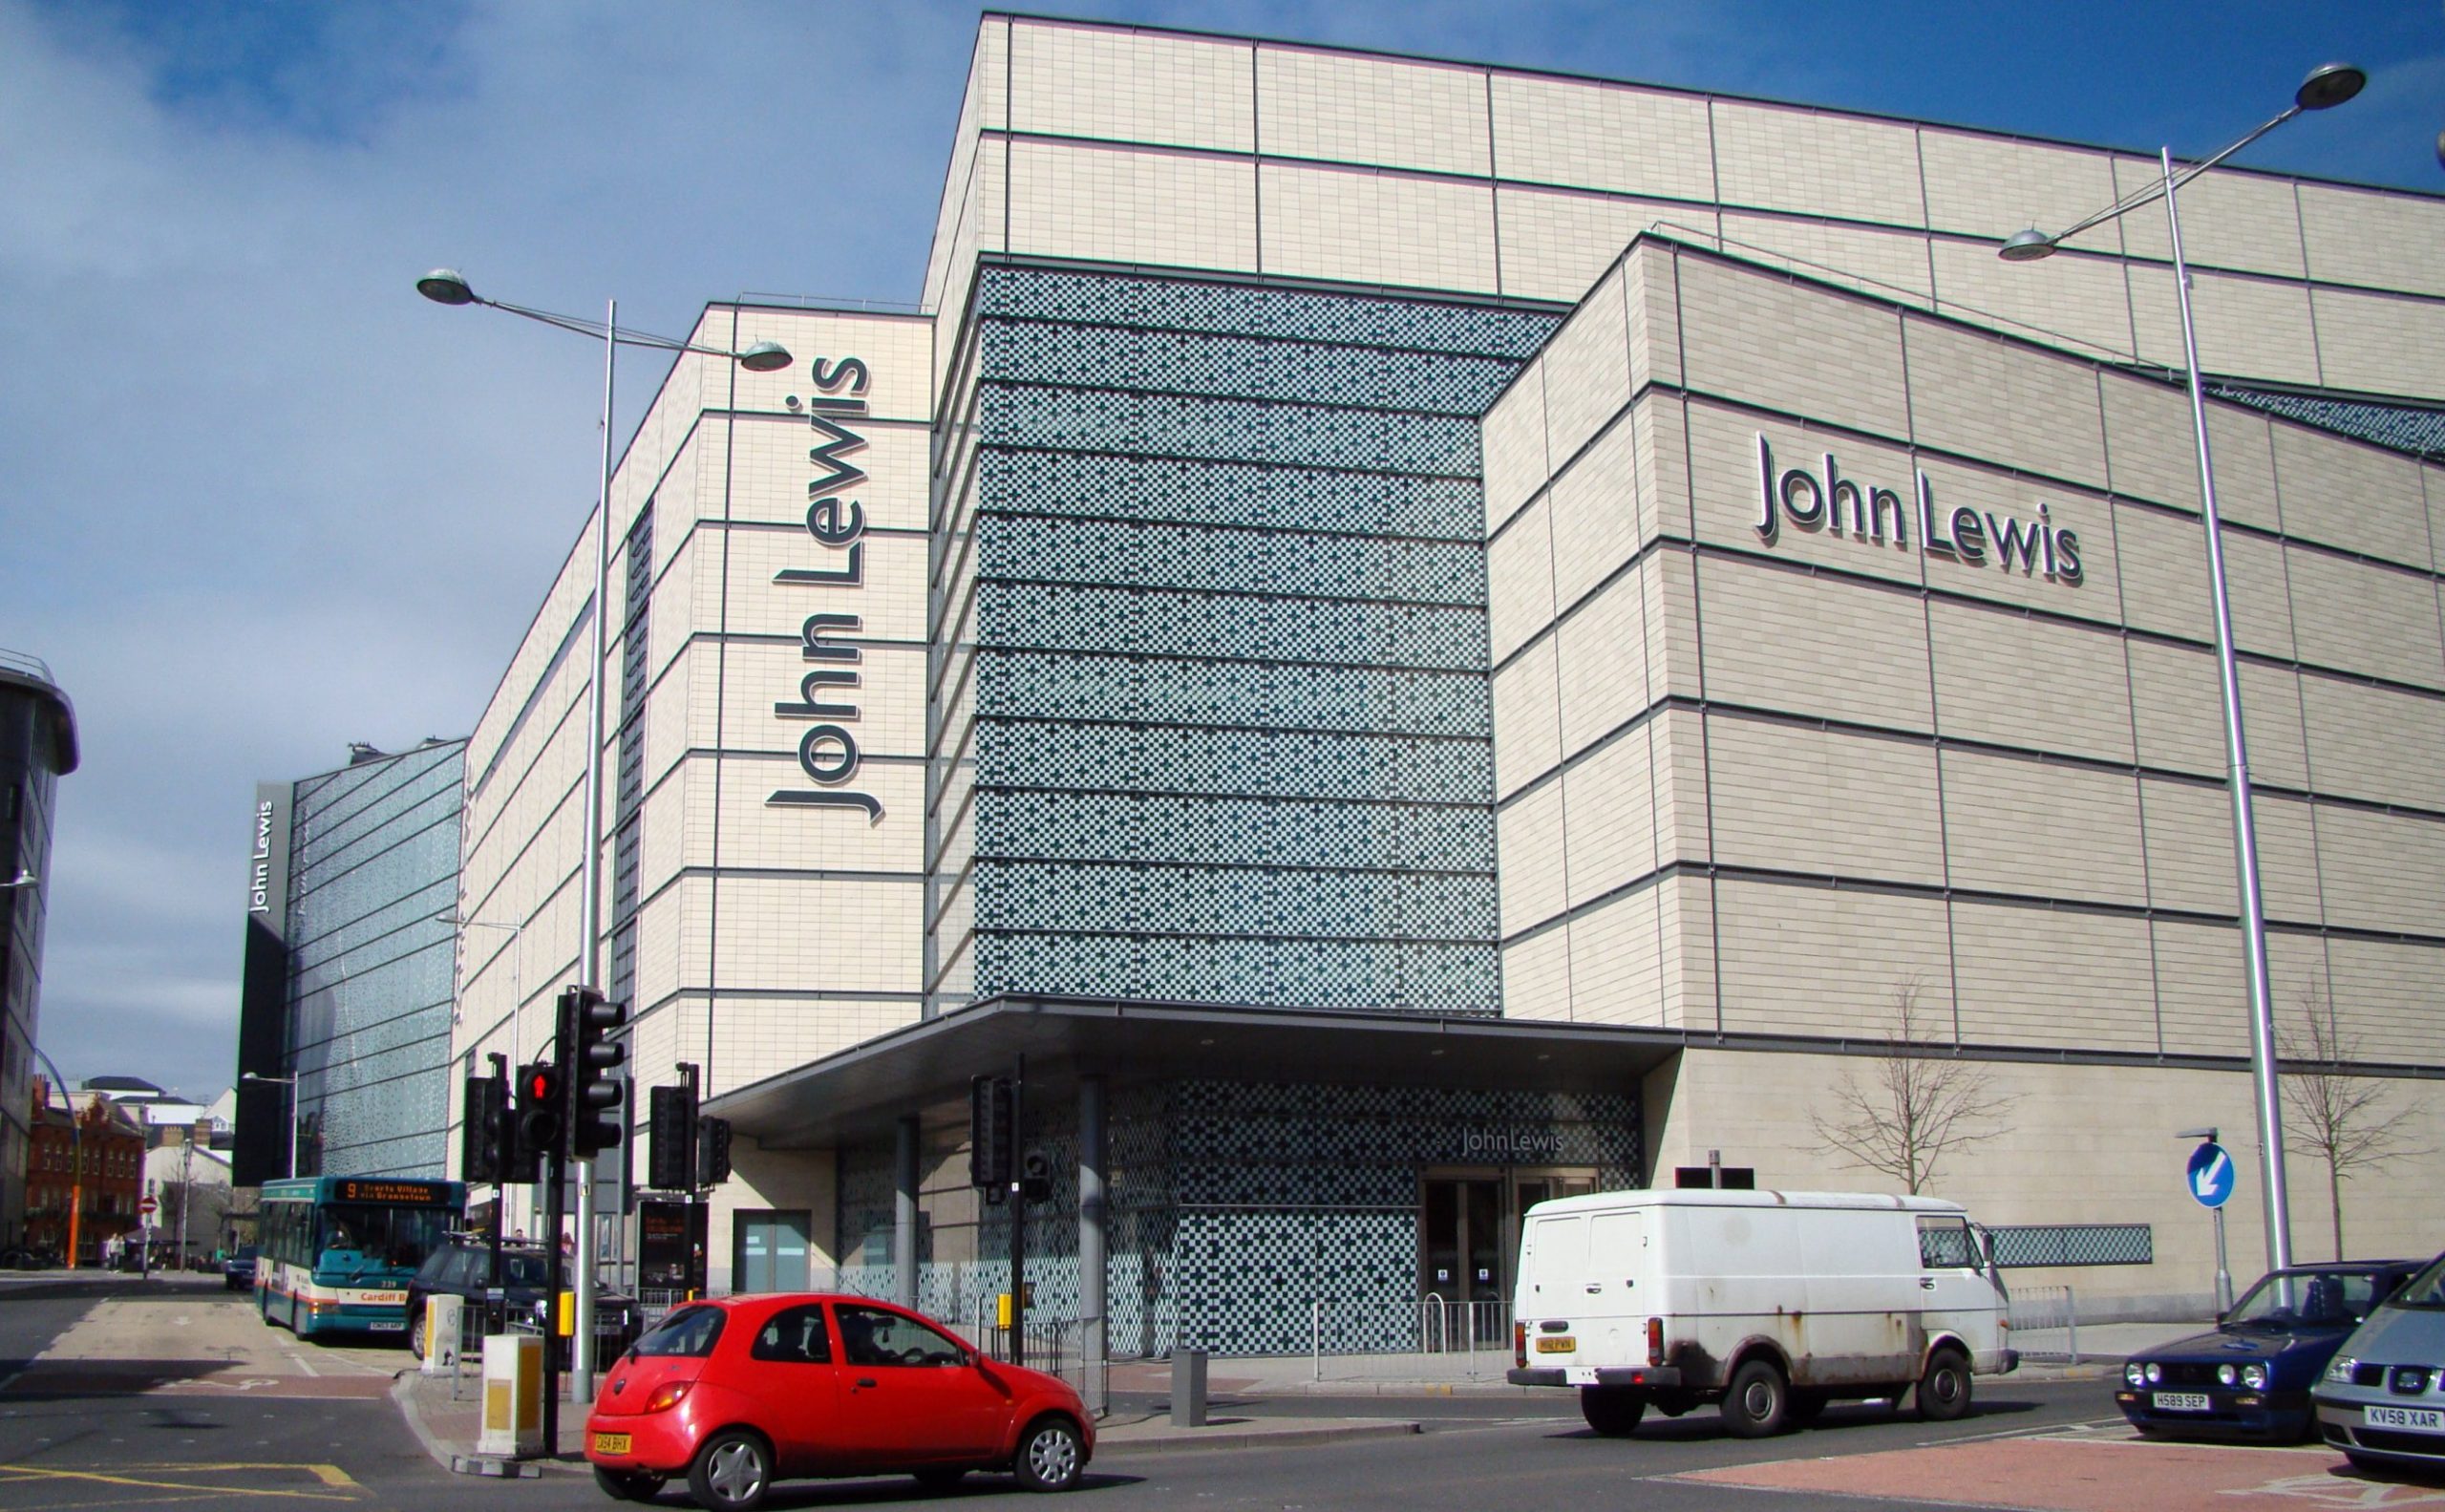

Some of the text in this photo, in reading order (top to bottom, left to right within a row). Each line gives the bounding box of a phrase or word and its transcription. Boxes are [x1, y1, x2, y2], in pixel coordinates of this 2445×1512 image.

[1753, 430, 2082, 580] John Lewis
[765, 356, 884, 827] John Lewis
[249, 800, 272, 913] John Lewis
[347, 1183, 357, 1199] 9
[360, 1292, 397, 1302] Cardiff
[2185, 1395, 2205, 1408] SEP
[2369, 1407, 2438, 1428] KV58 XAR
